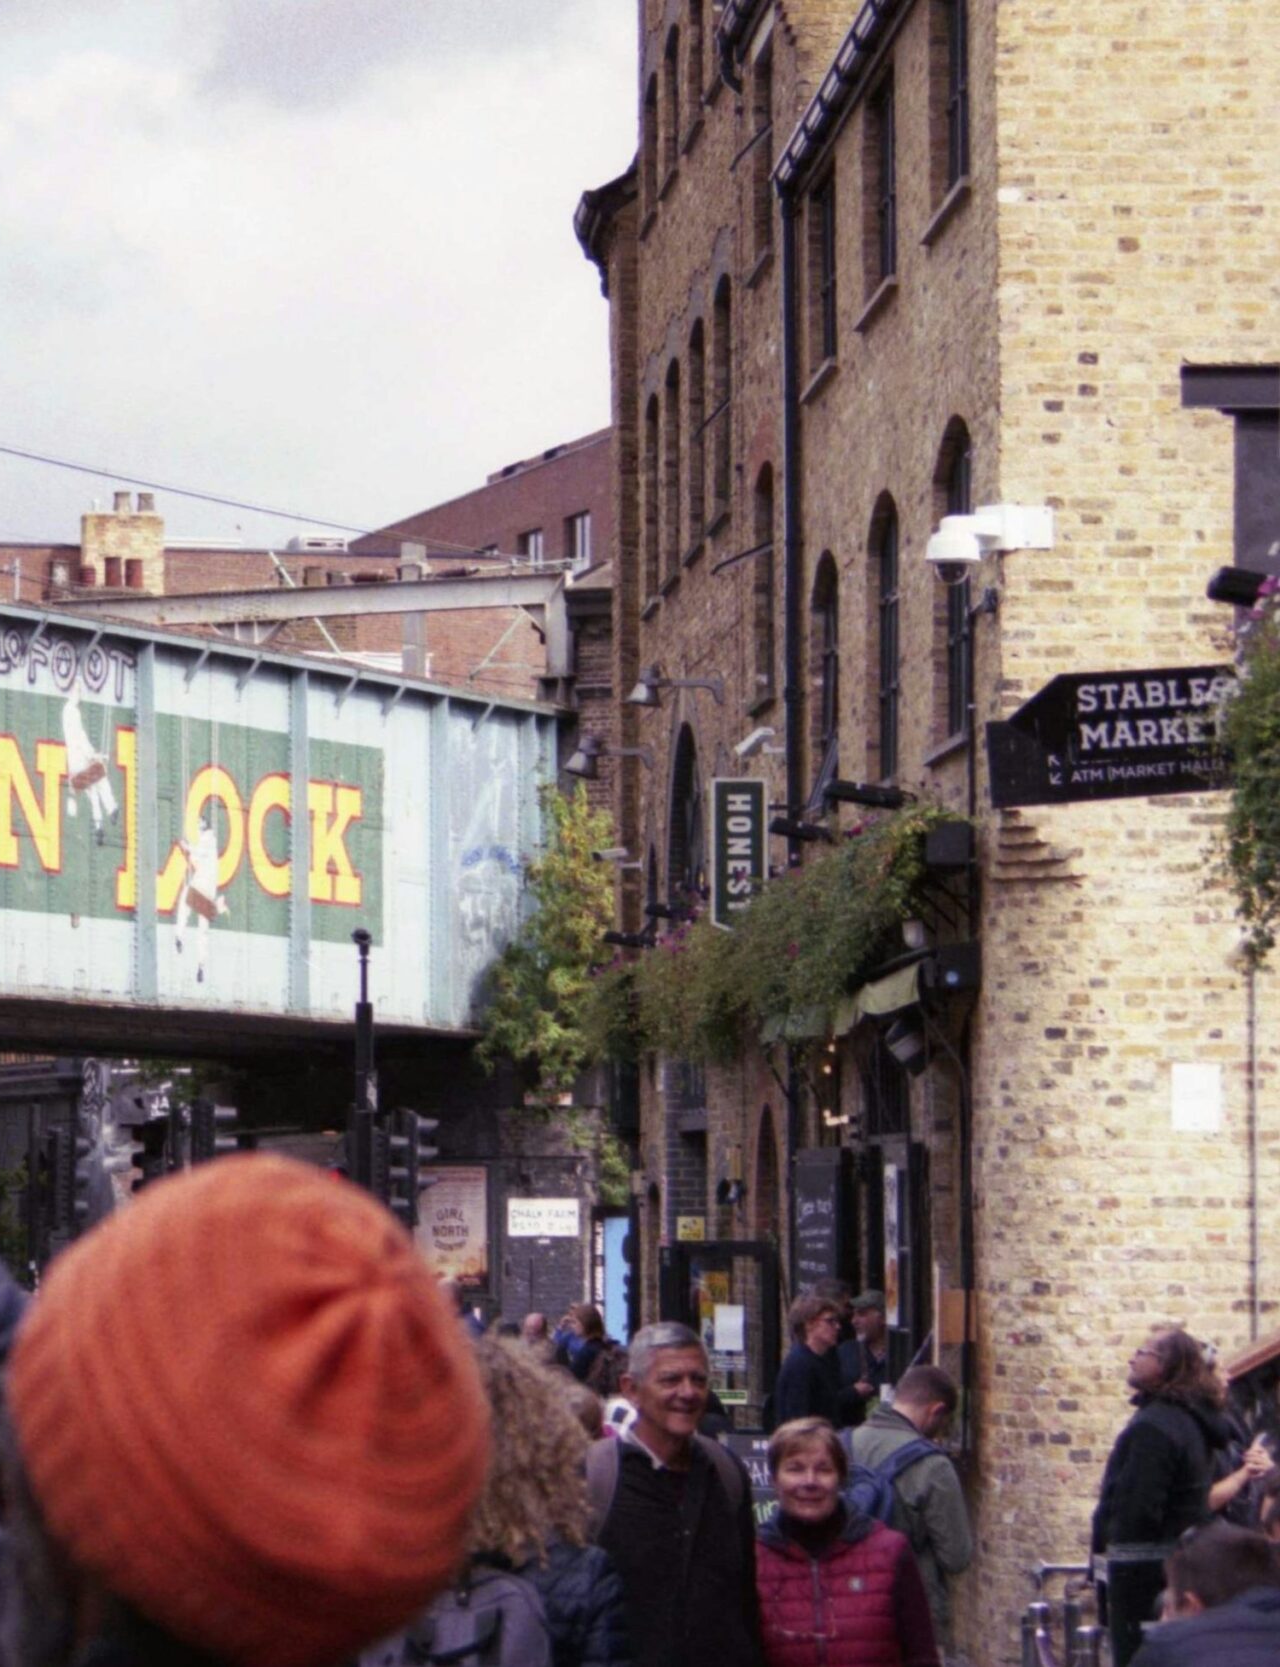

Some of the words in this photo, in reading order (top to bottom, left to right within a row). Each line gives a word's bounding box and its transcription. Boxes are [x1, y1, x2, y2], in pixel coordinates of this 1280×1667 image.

[1071, 768, 1104, 783] ATM
[116, 724, 364, 916] LOCK
[727, 794, 752, 911] HONEST
[431, 1225, 469, 1238] NORTH
